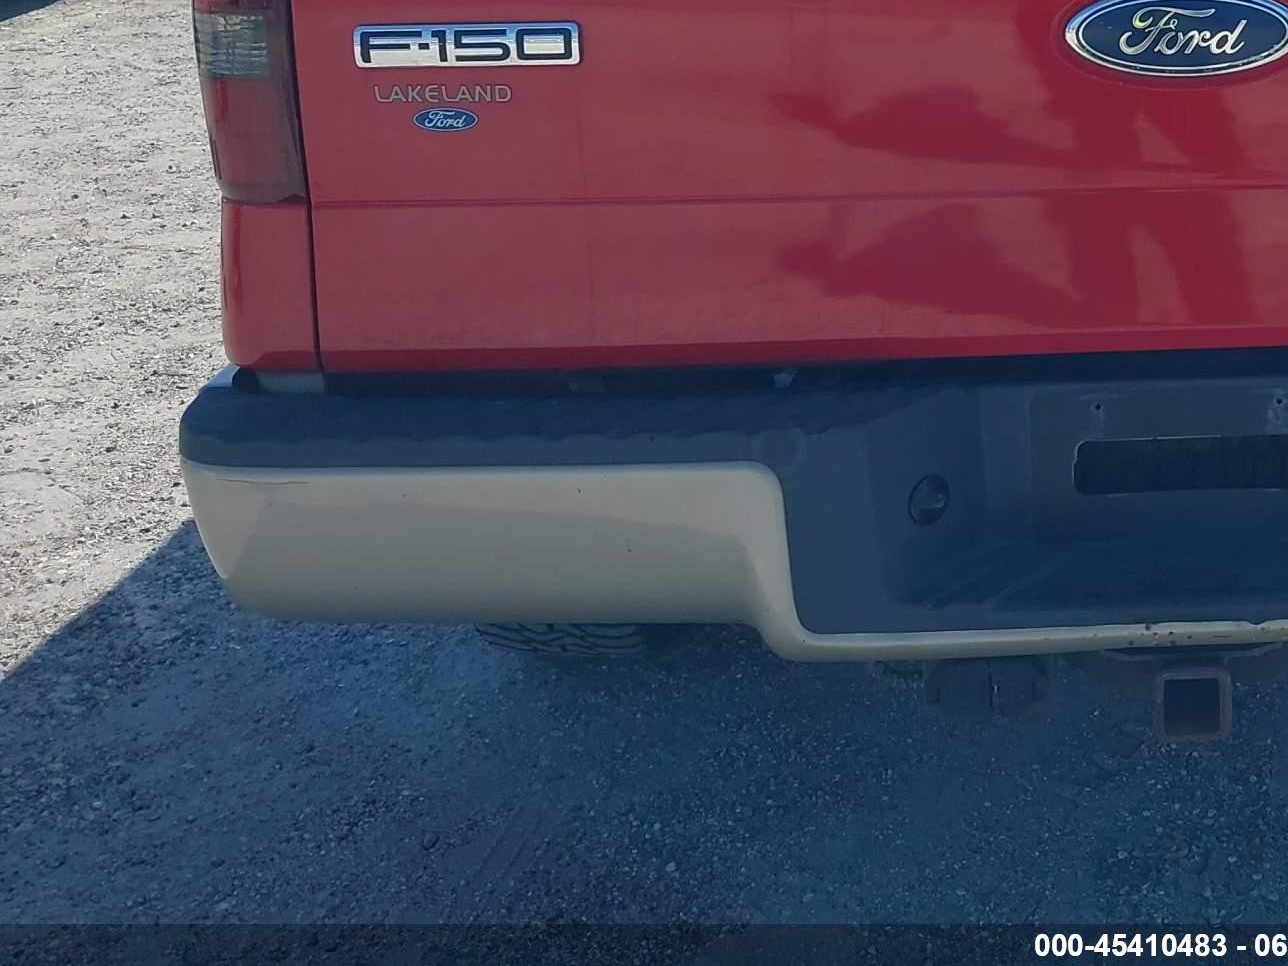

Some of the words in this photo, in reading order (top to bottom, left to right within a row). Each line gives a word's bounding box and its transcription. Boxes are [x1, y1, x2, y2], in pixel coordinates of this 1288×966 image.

[1118, 5, 1249, 56] Ford
[359, 27, 573, 64] F-150
[373, 84, 513, 104] LAKELAND
[424, 109, 467, 128] Ford
